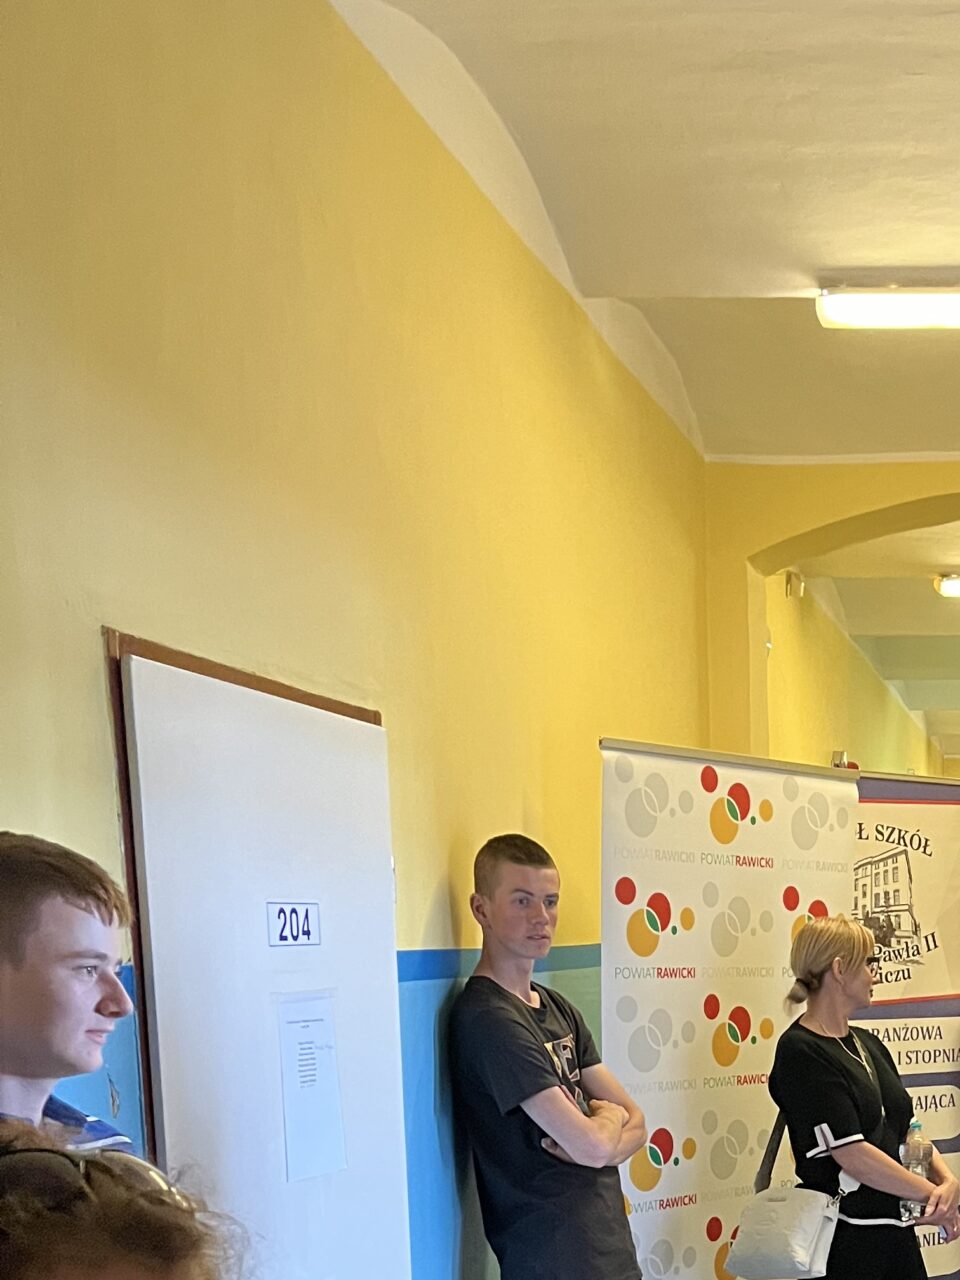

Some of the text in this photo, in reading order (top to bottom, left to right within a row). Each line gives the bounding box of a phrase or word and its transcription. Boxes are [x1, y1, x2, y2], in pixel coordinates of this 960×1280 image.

[875, 823, 933, 857] SZKÓŁ
[701, 852, 774, 869] POWIATRAWICKI
[277, 907, 311, 941] 204
[873, 931, 939, 963] Pawła II
[614, 967, 695, 980] POWIATRAWICKI
[878, 966, 911, 984] iczu
[912, 1093, 956, 1112] AJĄCA
